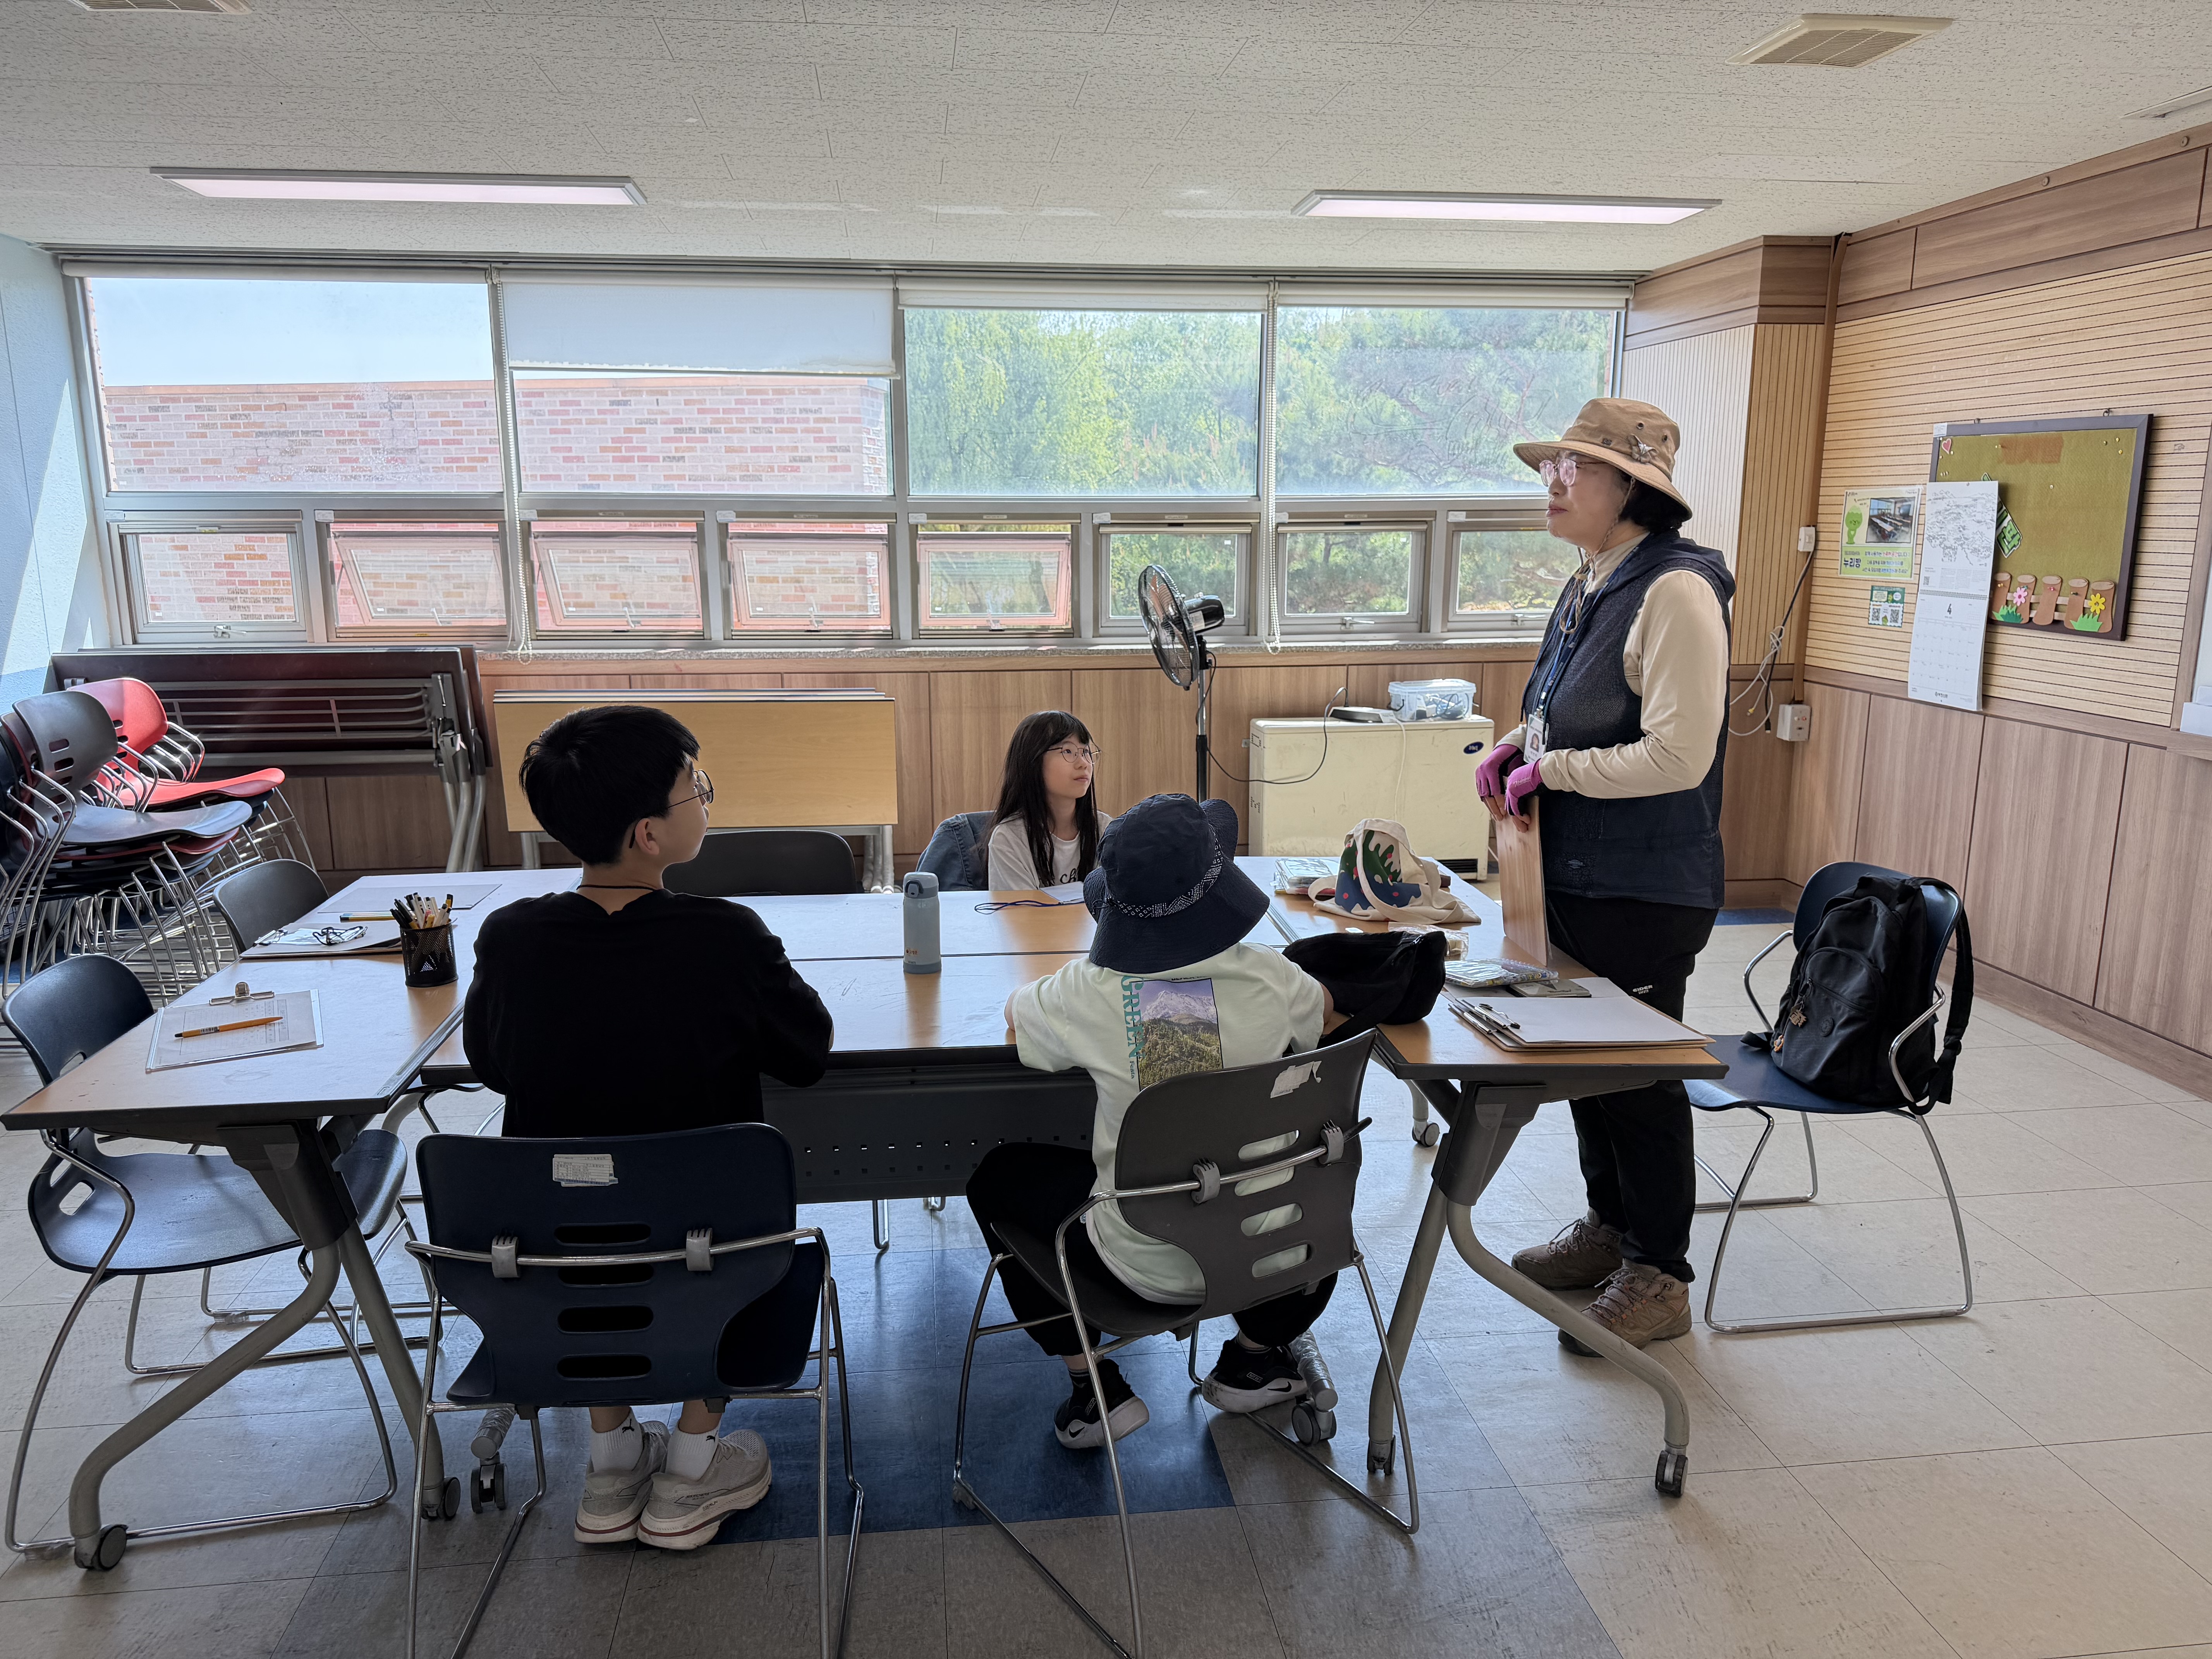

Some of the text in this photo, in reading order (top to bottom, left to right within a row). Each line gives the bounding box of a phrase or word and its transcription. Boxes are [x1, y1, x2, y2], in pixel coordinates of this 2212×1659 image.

[1843, 558, 1861, 568] 누리방
[1947, 603, 1952, 615] 4
[1121, 975, 1146, 1058] GREEN
